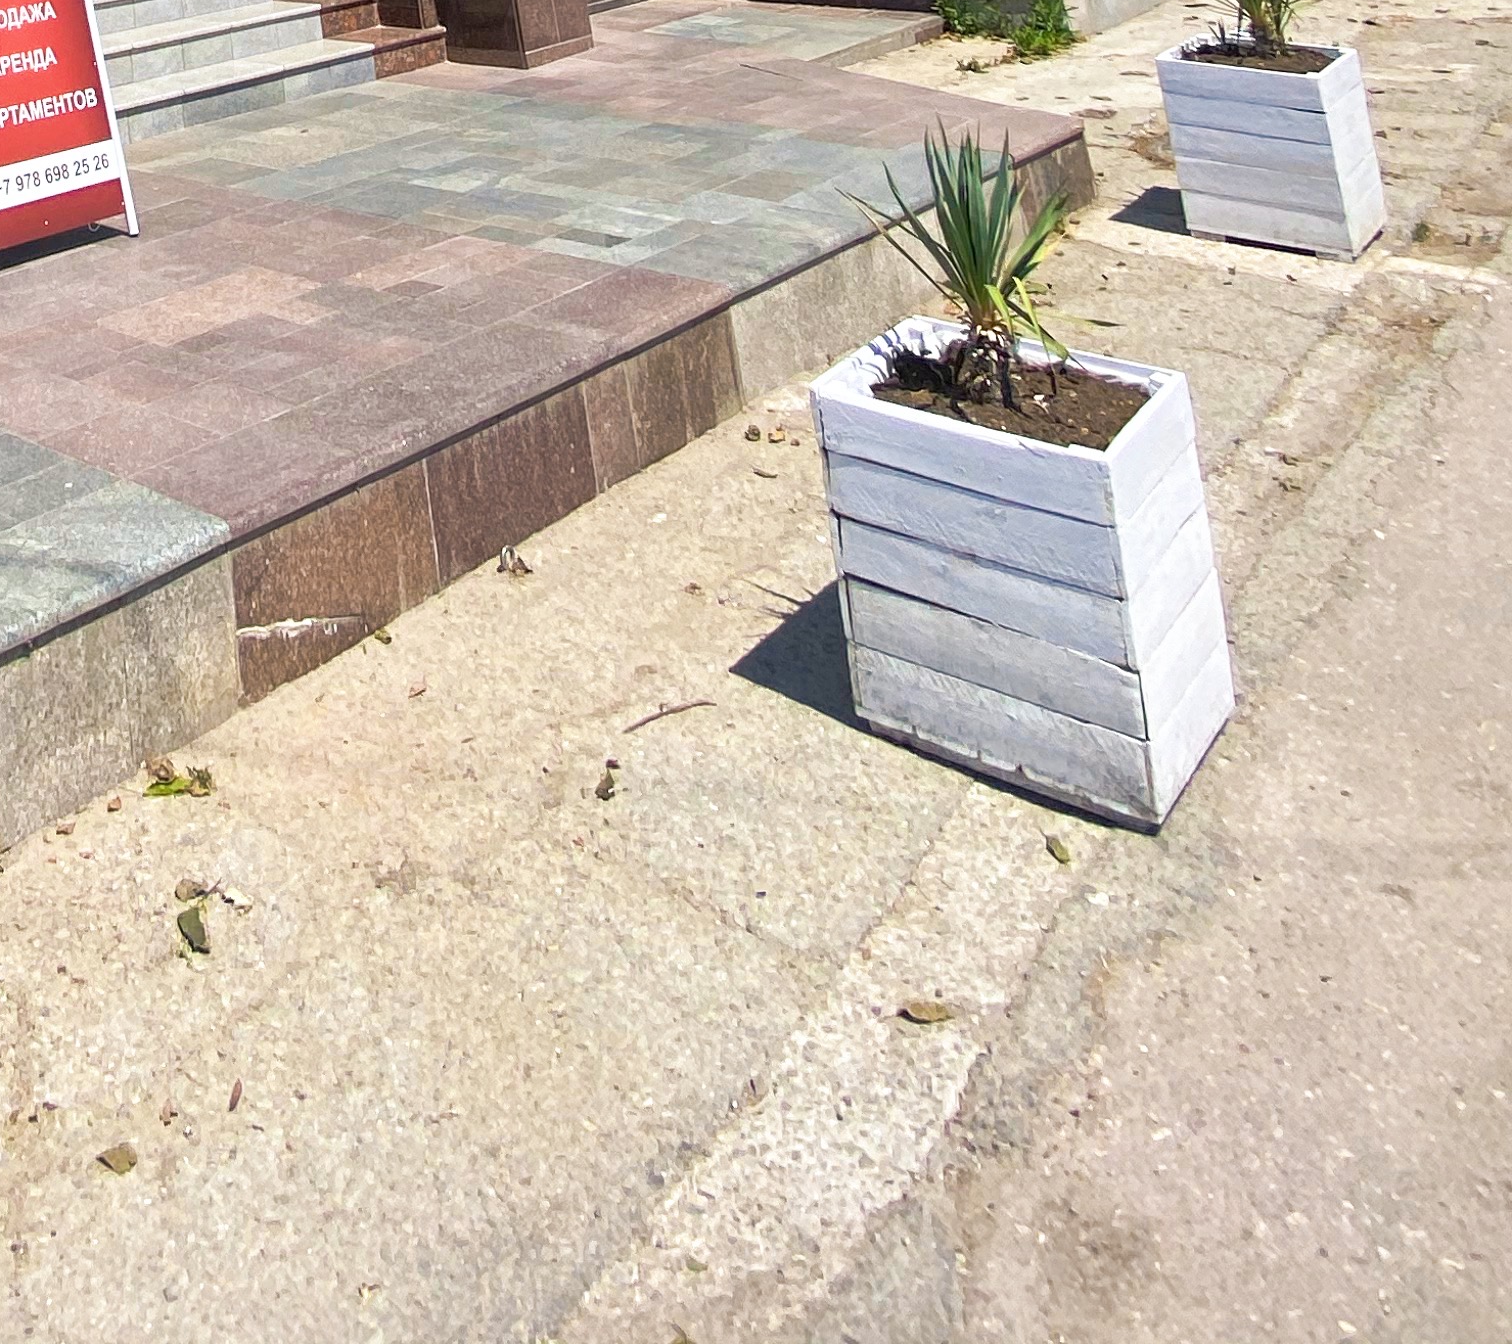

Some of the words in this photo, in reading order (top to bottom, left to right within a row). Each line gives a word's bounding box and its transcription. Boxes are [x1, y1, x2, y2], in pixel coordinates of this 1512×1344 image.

[16, 171, 40, 192] 978
[45, 164, 69, 184] 698
[74, 159, 90, 176] 25
[93, 153, 109, 171] 26
